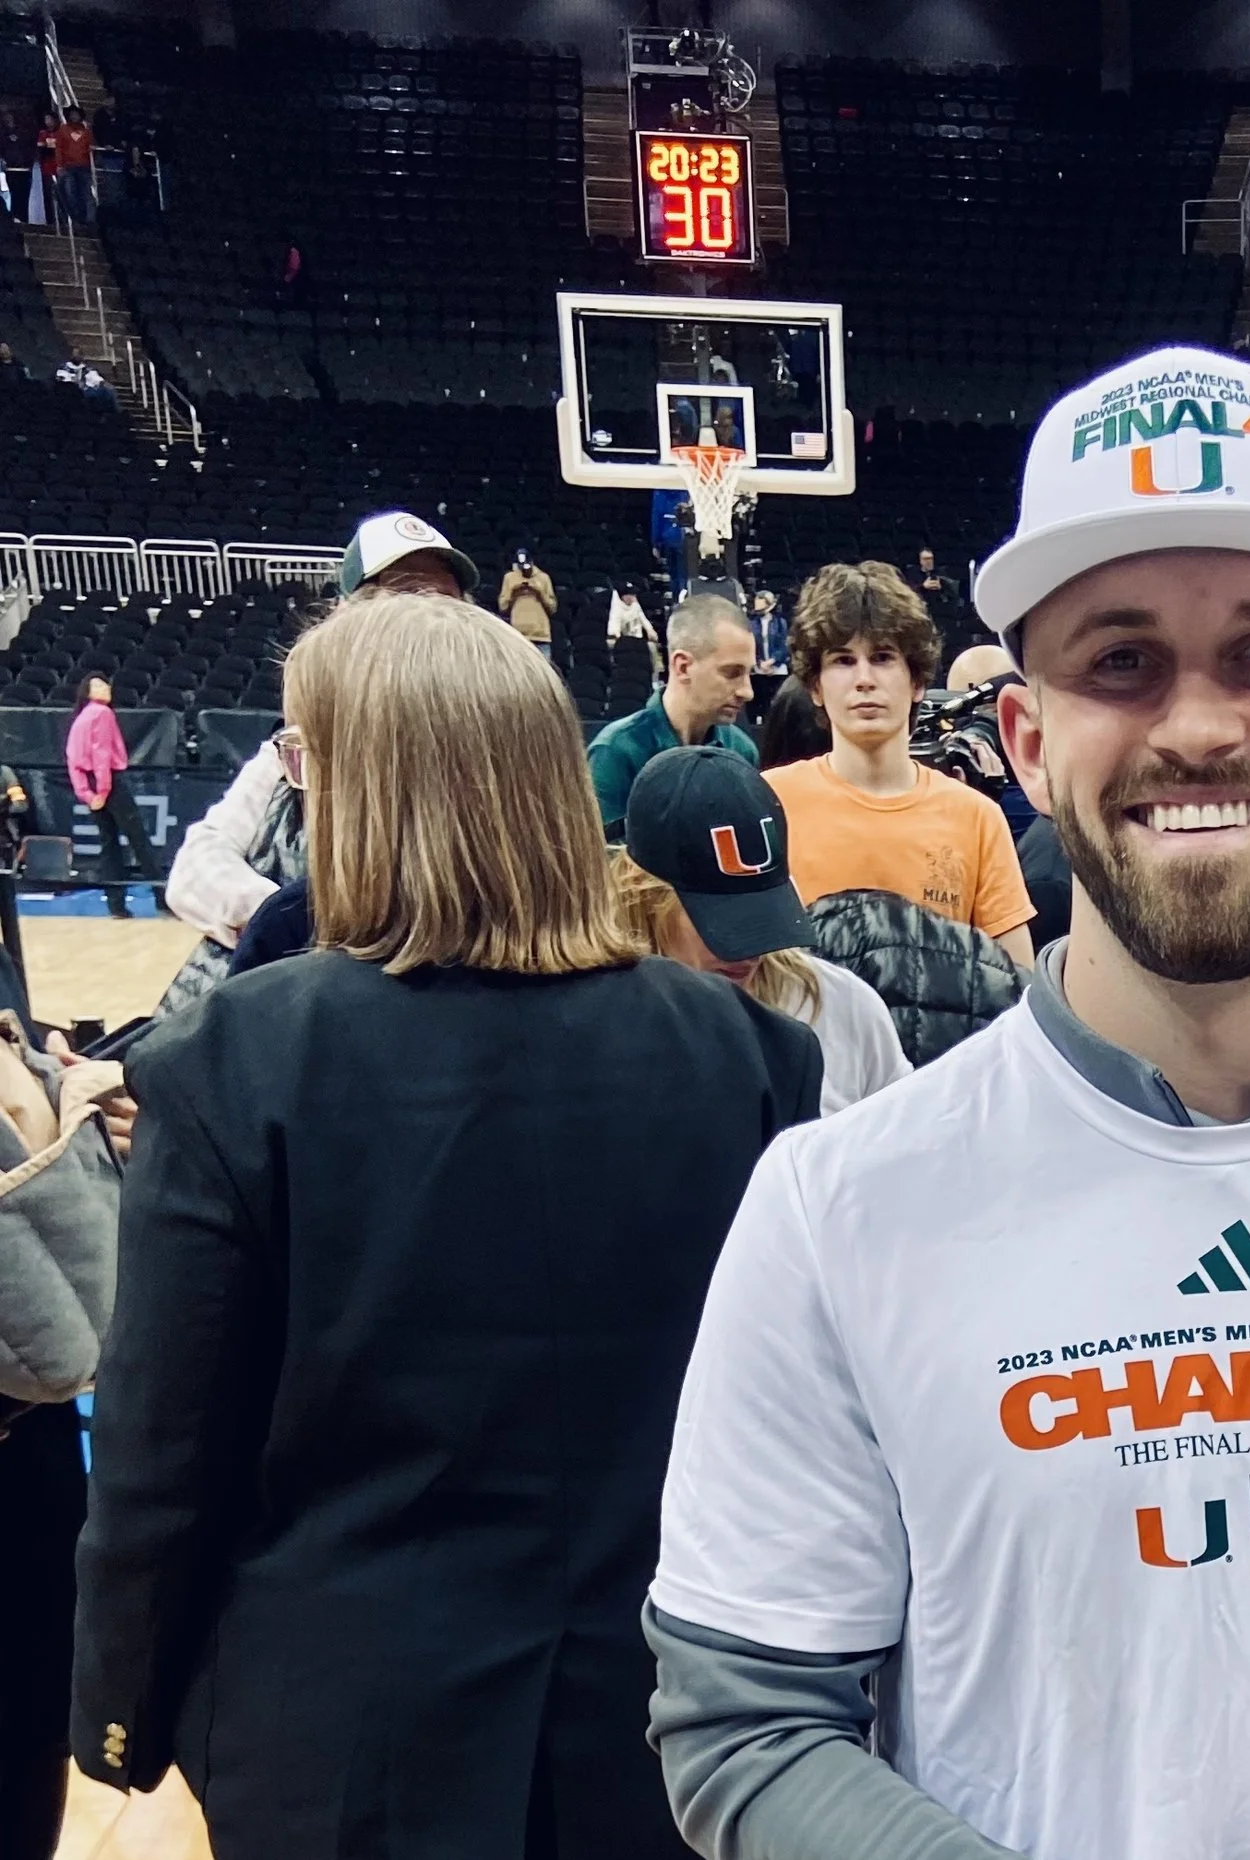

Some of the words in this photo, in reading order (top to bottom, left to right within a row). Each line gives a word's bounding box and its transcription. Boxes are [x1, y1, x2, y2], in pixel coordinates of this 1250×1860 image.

[649, 143, 740, 184] 20:23
[664, 185, 733, 247] 30
[1074, 396, 1137, 429] MIDWEST
[1140, 386, 1217, 405] REGIONAL
[1101, 383, 1134, 405] 2023
[1195, 373, 1244, 391] MEN'S
[710, 816, 779, 877] U
[996, 1349, 1055, 1374] 2023
[1140, 1325, 1217, 1349] MEN'S
[1114, 1438, 1171, 1468] THE
[1174, 1431, 1250, 1460] FINAL
